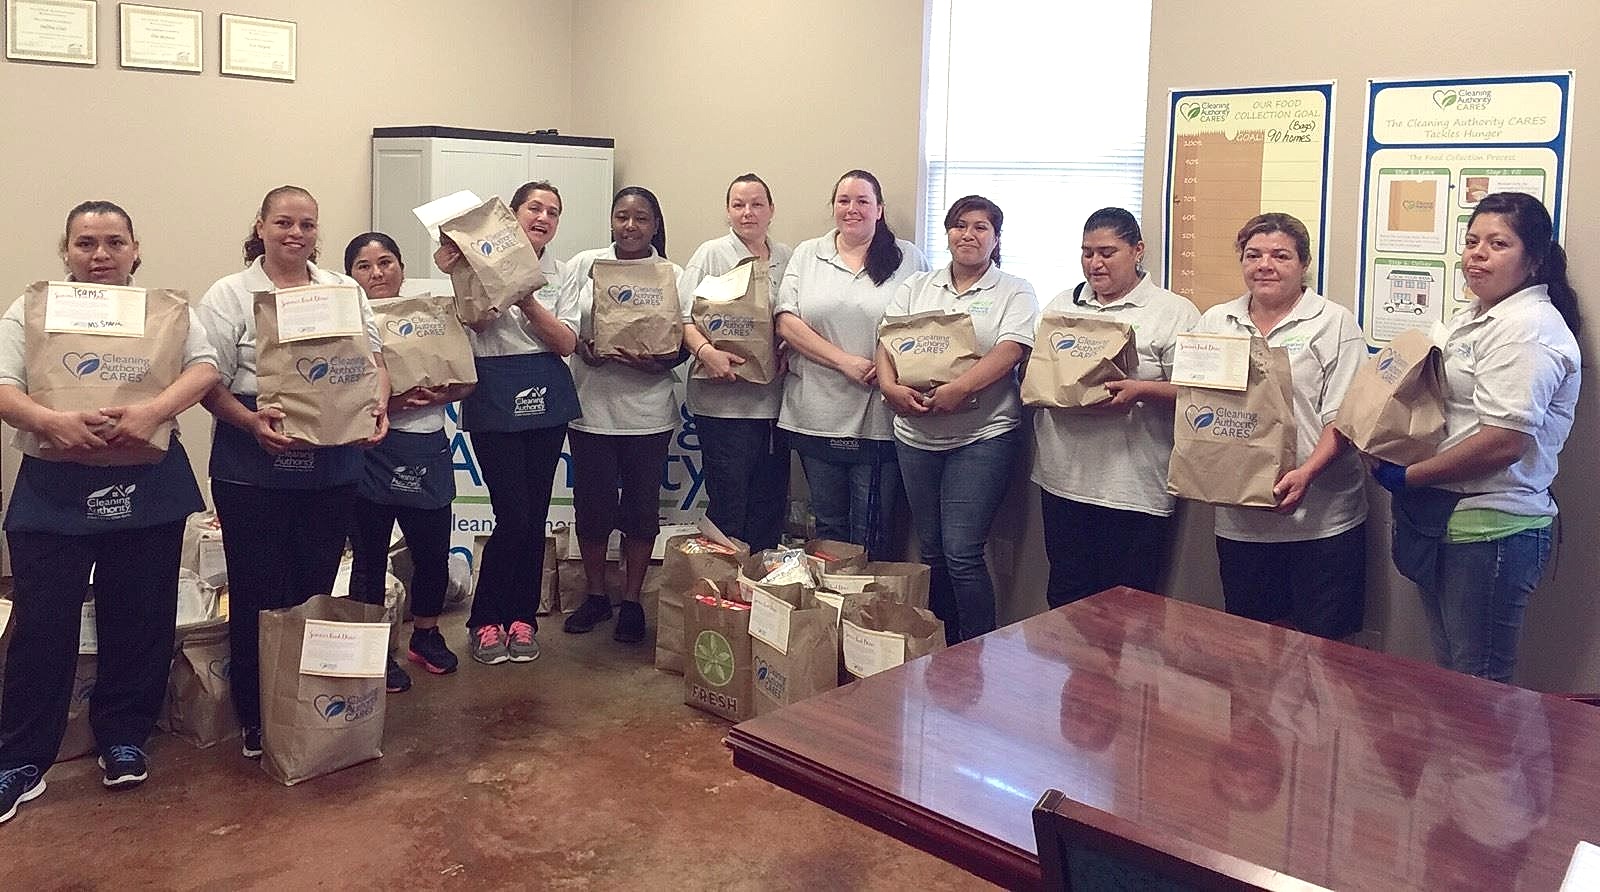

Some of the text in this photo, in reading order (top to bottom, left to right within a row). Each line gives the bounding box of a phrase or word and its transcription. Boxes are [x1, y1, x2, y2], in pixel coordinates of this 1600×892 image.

[1458, 89, 1492, 98] Cleaning
[1201, 102, 1230, 110] Cleaning
[1252, 99, 1302, 109] OUR FOOD
[1456, 96, 1492, 105] Authority
[1456, 103, 1487, 111] CARES
[1200, 109, 1230, 117] Authority
[1234, 109, 1320, 120] COLLECTION GOAL
[1385, 116, 1547, 129] The Cleaning Authority CARES
[1267, 128, 1312, 143] 90 homes
[1424, 129, 1503, 140] Tackles Hunger
[1487, 153, 1517, 161] Process
[633, 298, 661, 306] CARES
[722, 320, 754, 329] Authority
[721, 329, 750, 337] CARES
[916, 335, 951, 345] Cleaning
[914, 346, 944, 355] CARES
[916, 341, 951, 352] Authority
[101, 353, 150, 366] Cleaning
[330, 356, 366, 367] Cleaning
[100, 364, 151, 374] Authority
[328, 365, 367, 375] Authority
[100, 372, 143, 383] CARES
[329, 374, 361, 385] CARES
[1215, 407, 1258, 421] Cleaning
[1214, 416, 1258, 432] Authority
[1212, 426, 1251, 439] CARES
[87, 497, 131, 508] Cleaning
[453, 514, 493, 531] lean
[691, 686, 738, 712] FRESH
